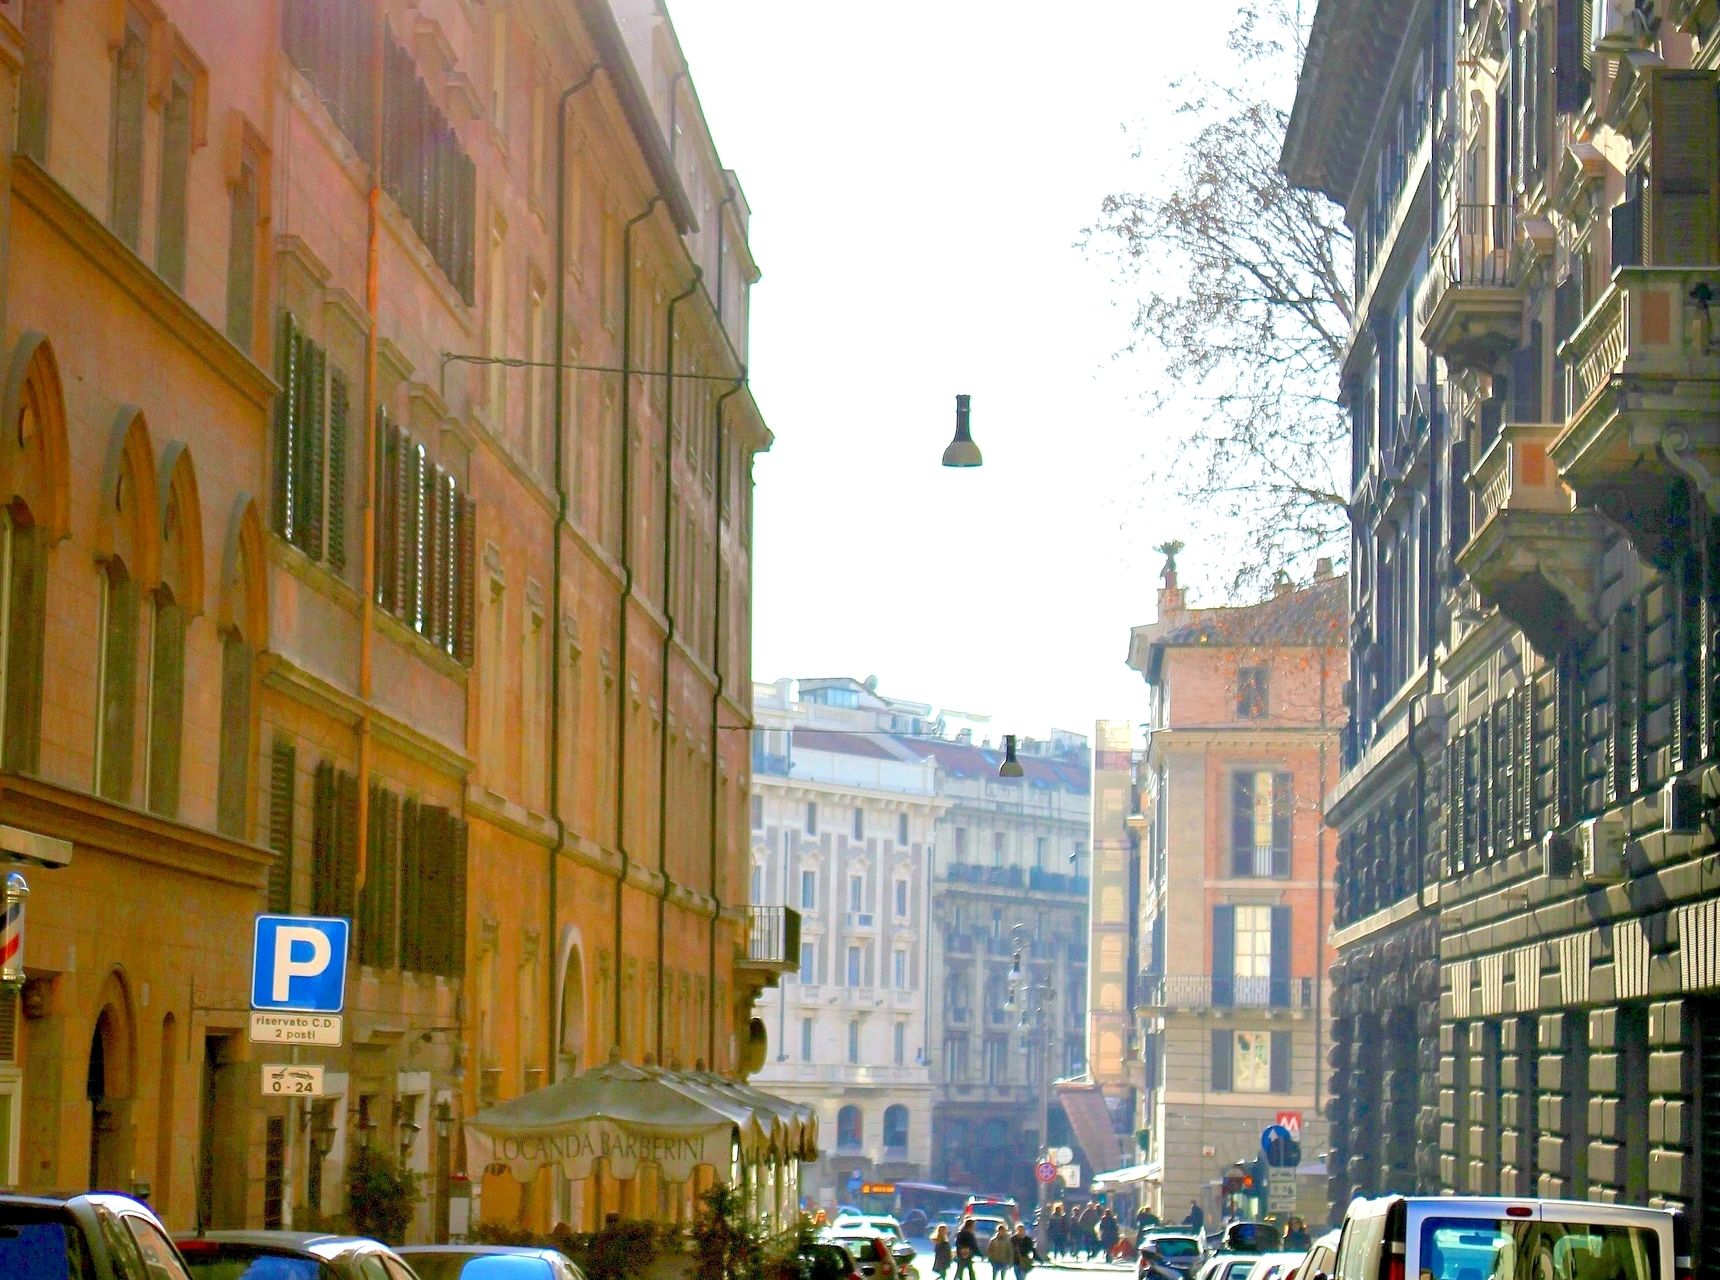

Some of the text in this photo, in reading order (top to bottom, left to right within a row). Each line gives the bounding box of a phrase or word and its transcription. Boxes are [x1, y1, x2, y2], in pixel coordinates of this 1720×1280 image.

[272, 926, 331, 1002] P
[256, 1016, 335, 1028] riservato C.D.
[275, 1029, 315, 1040] 2 posti
[295, 1082, 313, 1093] 24
[1280, 1116, 1298, 1131] M
[491, 1132, 705, 1162] LOCANDA BARBERINI
